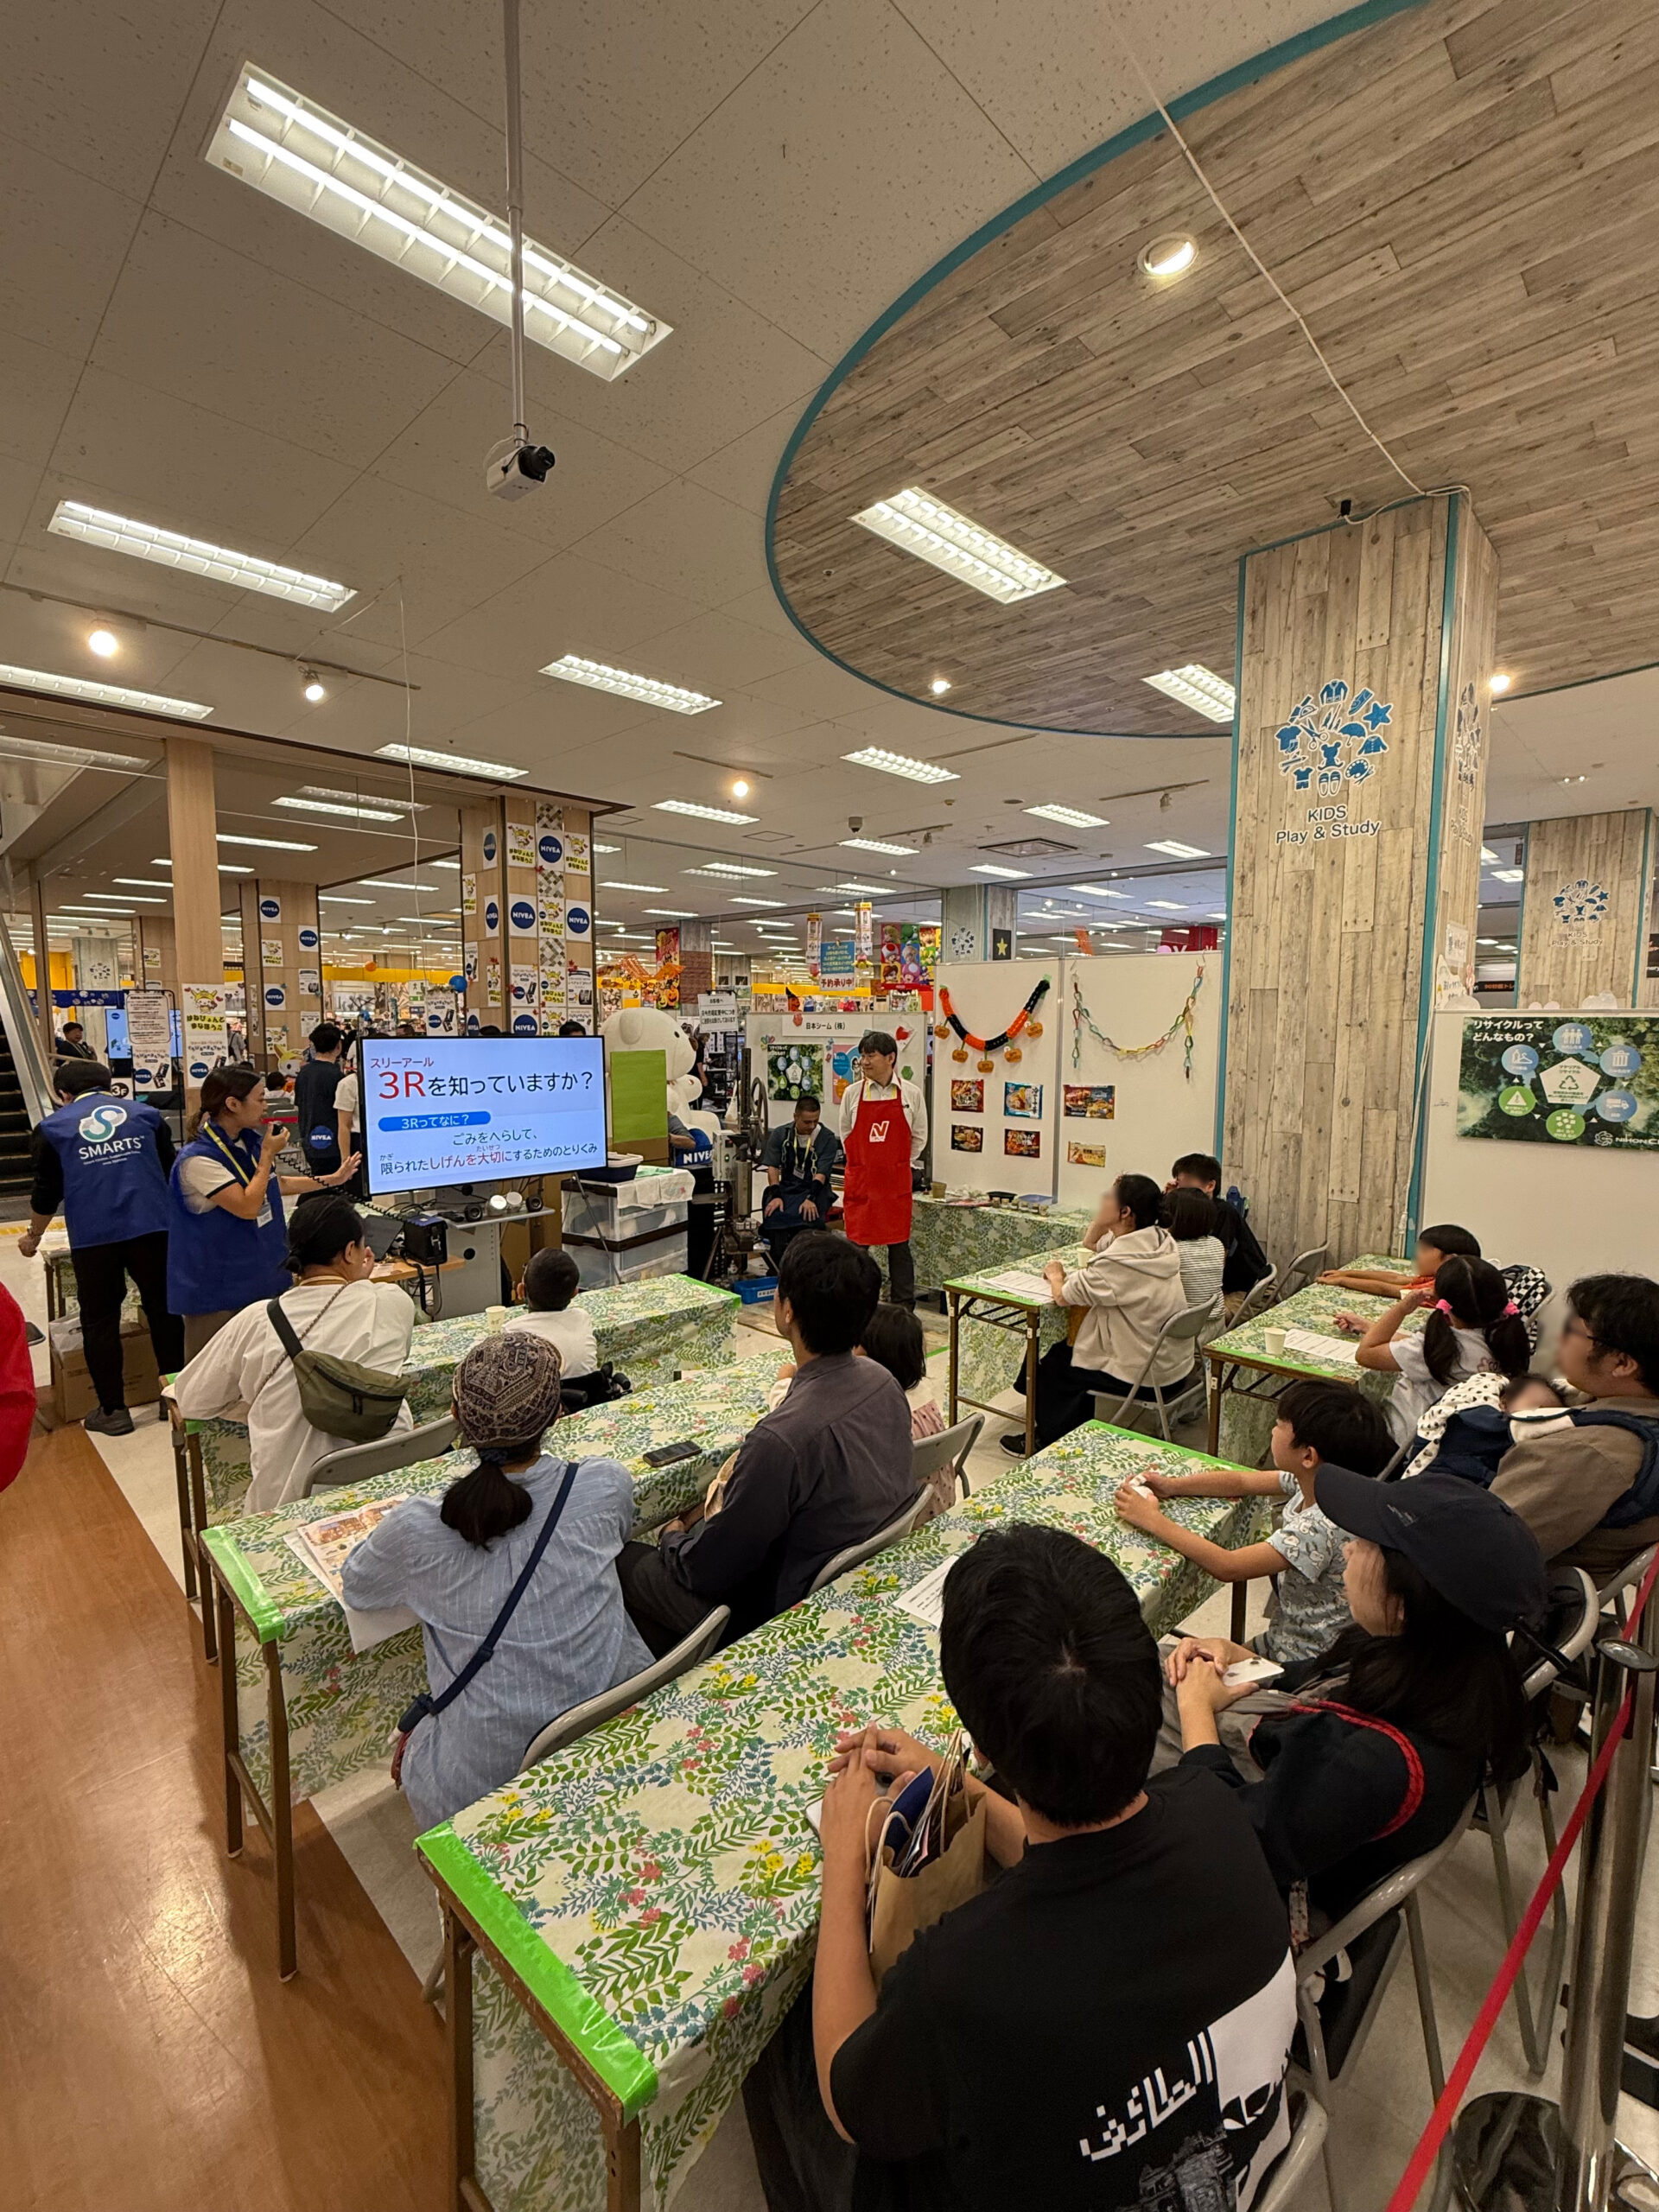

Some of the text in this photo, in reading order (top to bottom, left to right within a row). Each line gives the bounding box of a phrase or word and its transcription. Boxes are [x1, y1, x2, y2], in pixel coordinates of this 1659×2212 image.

[1307, 805, 1347, 823] KIDS
[1276, 820, 1381, 845] Play & Study
[1473, 1020, 1544, 1030] リサイクルって
[370, 1057, 435, 1069] スリーアール
[111, 1085, 127, 1096] 3F
[378, 1071, 594, 1100] 3Rを知っていますか？
[401, 1114, 470, 1129] 3Rってなに？
[452, 1128, 538, 1147] ごみをへらして、
[79, 1137, 143, 1160] SMARTS
[476, 1144, 501, 1153] たいせつ
[380, 1143, 598, 1175] 限られたしげんを大切にするためのとりくみ
